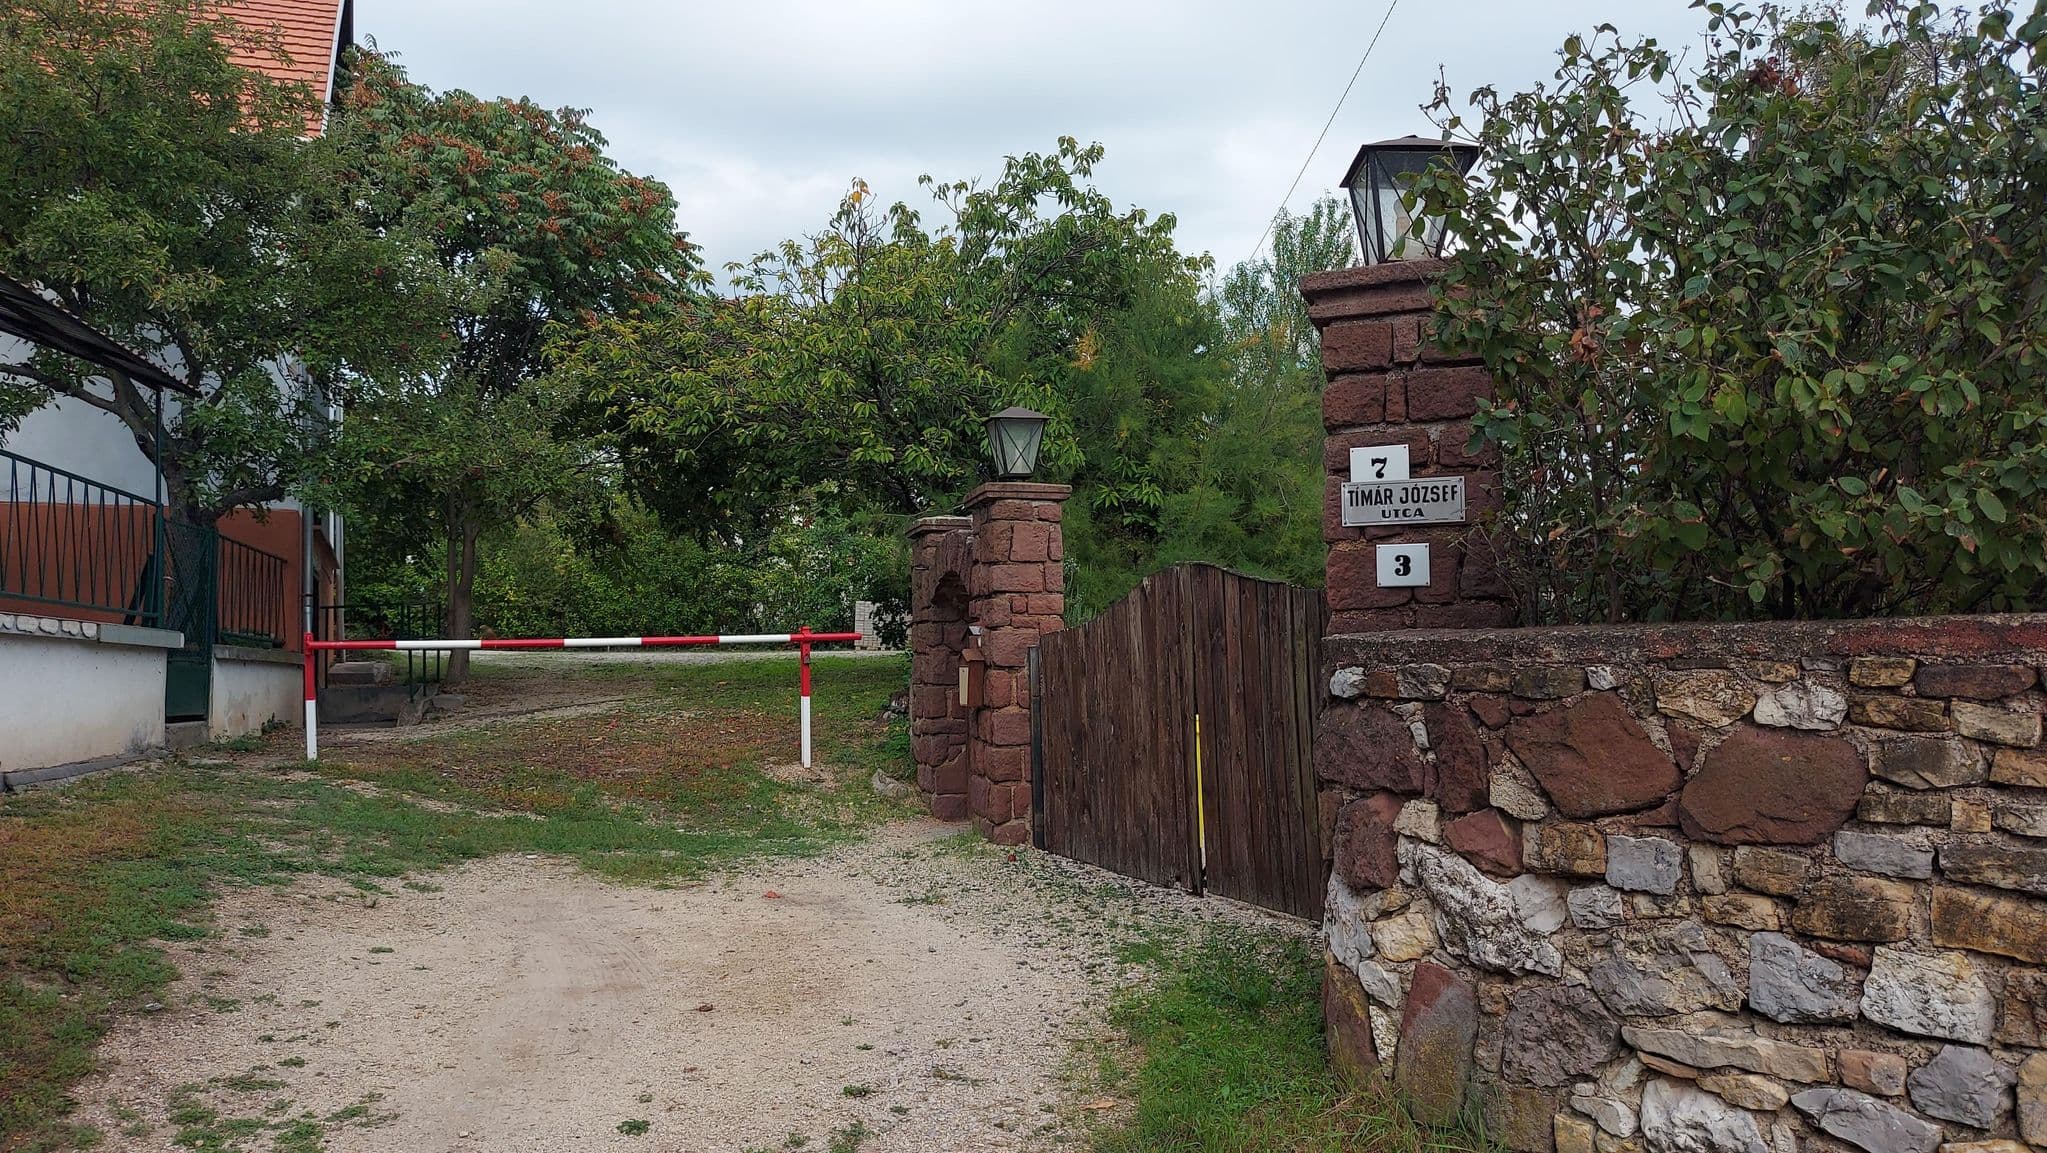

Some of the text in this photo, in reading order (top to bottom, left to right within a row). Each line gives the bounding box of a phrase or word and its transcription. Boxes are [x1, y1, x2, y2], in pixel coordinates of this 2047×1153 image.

[1371, 456, 1388, 479] 7
[1347, 483, 1458, 507] TÍMÁR JÓZSEF
[1381, 507, 1425, 519] UTCA
[1394, 554, 1412, 577] 3
